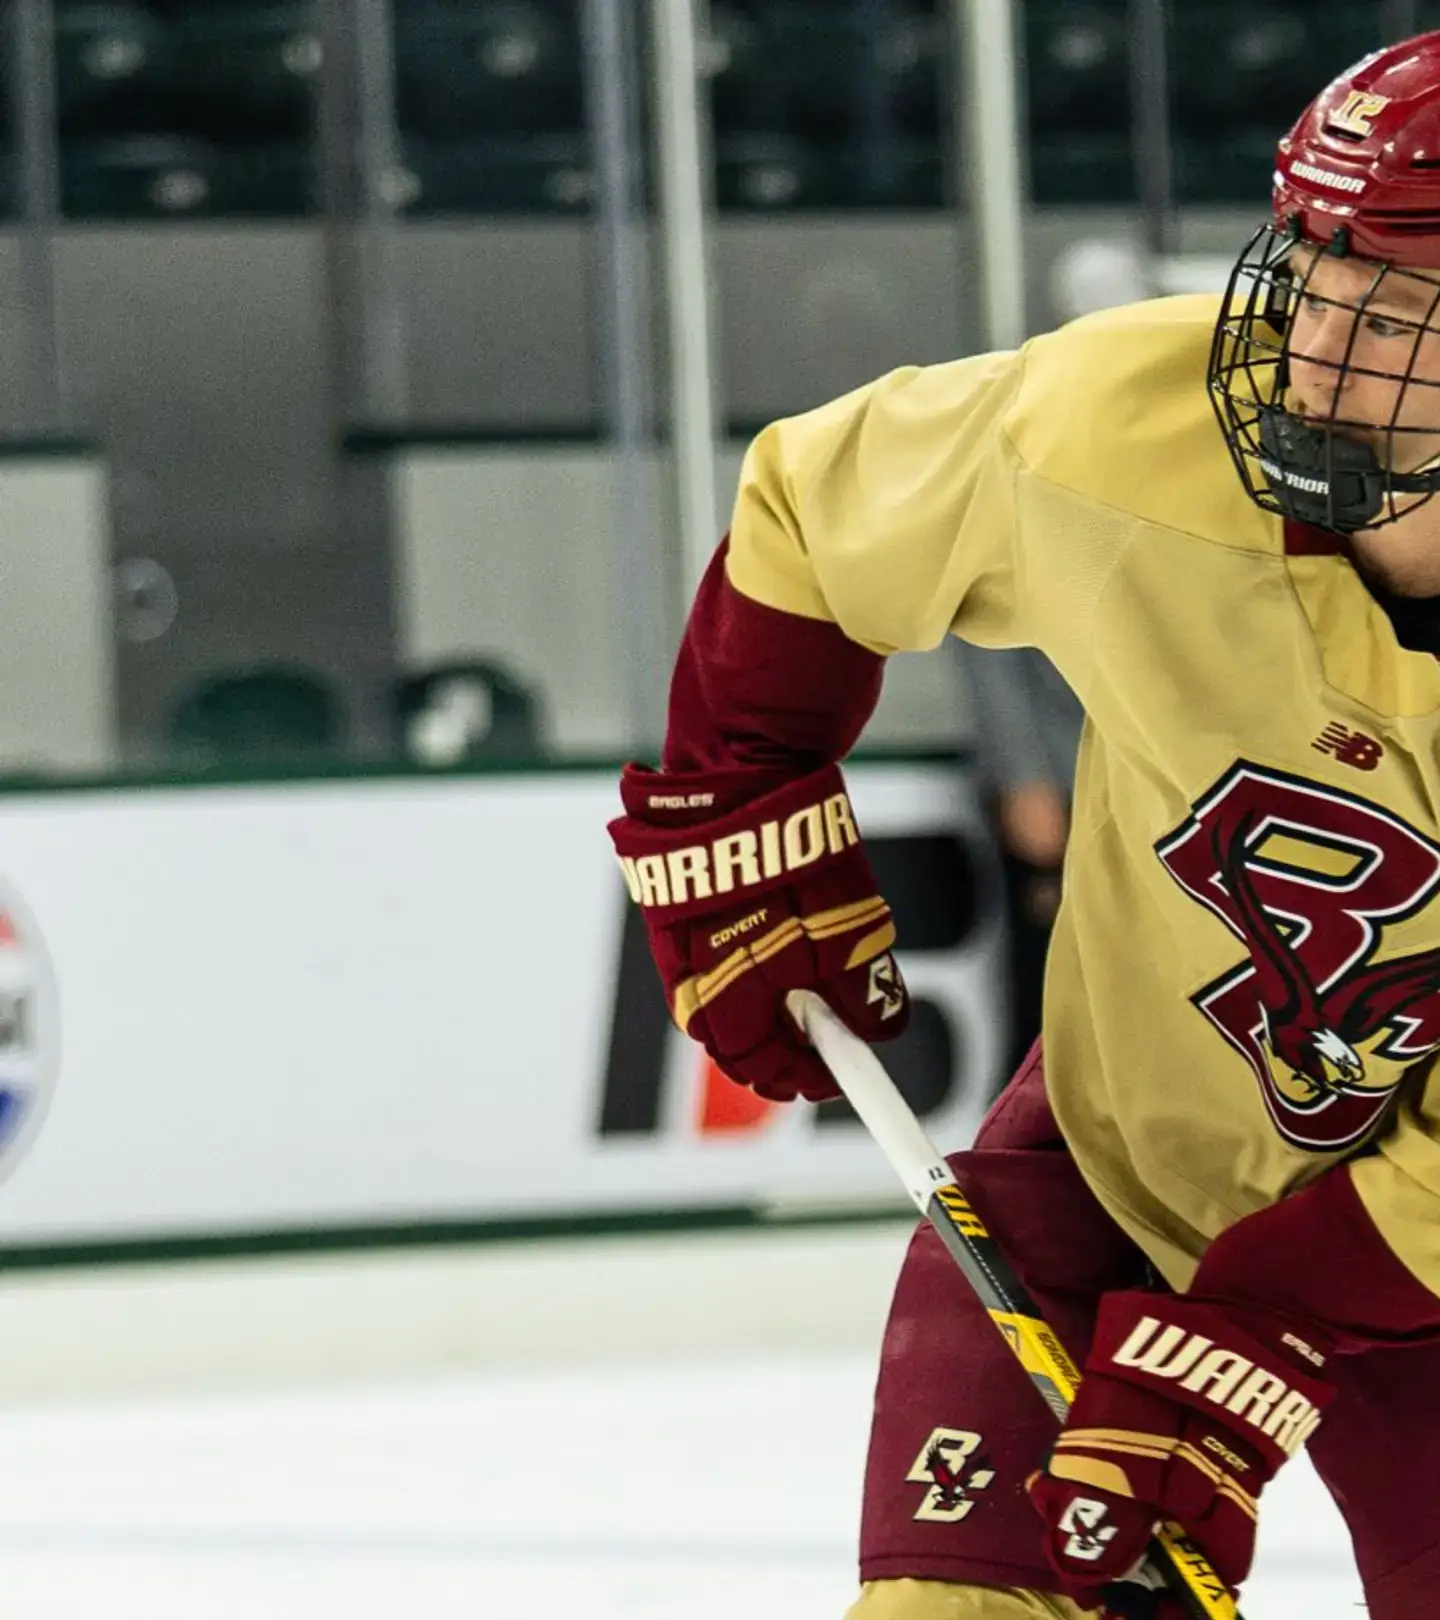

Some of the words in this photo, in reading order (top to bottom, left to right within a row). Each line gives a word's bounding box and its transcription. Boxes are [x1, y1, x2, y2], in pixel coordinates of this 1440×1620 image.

[1327, 90, 1392, 137] 12
[1289, 160, 1367, 194] WARRIOR
[648, 792, 715, 809] EAGLES
[710, 908, 768, 948] COVERT
